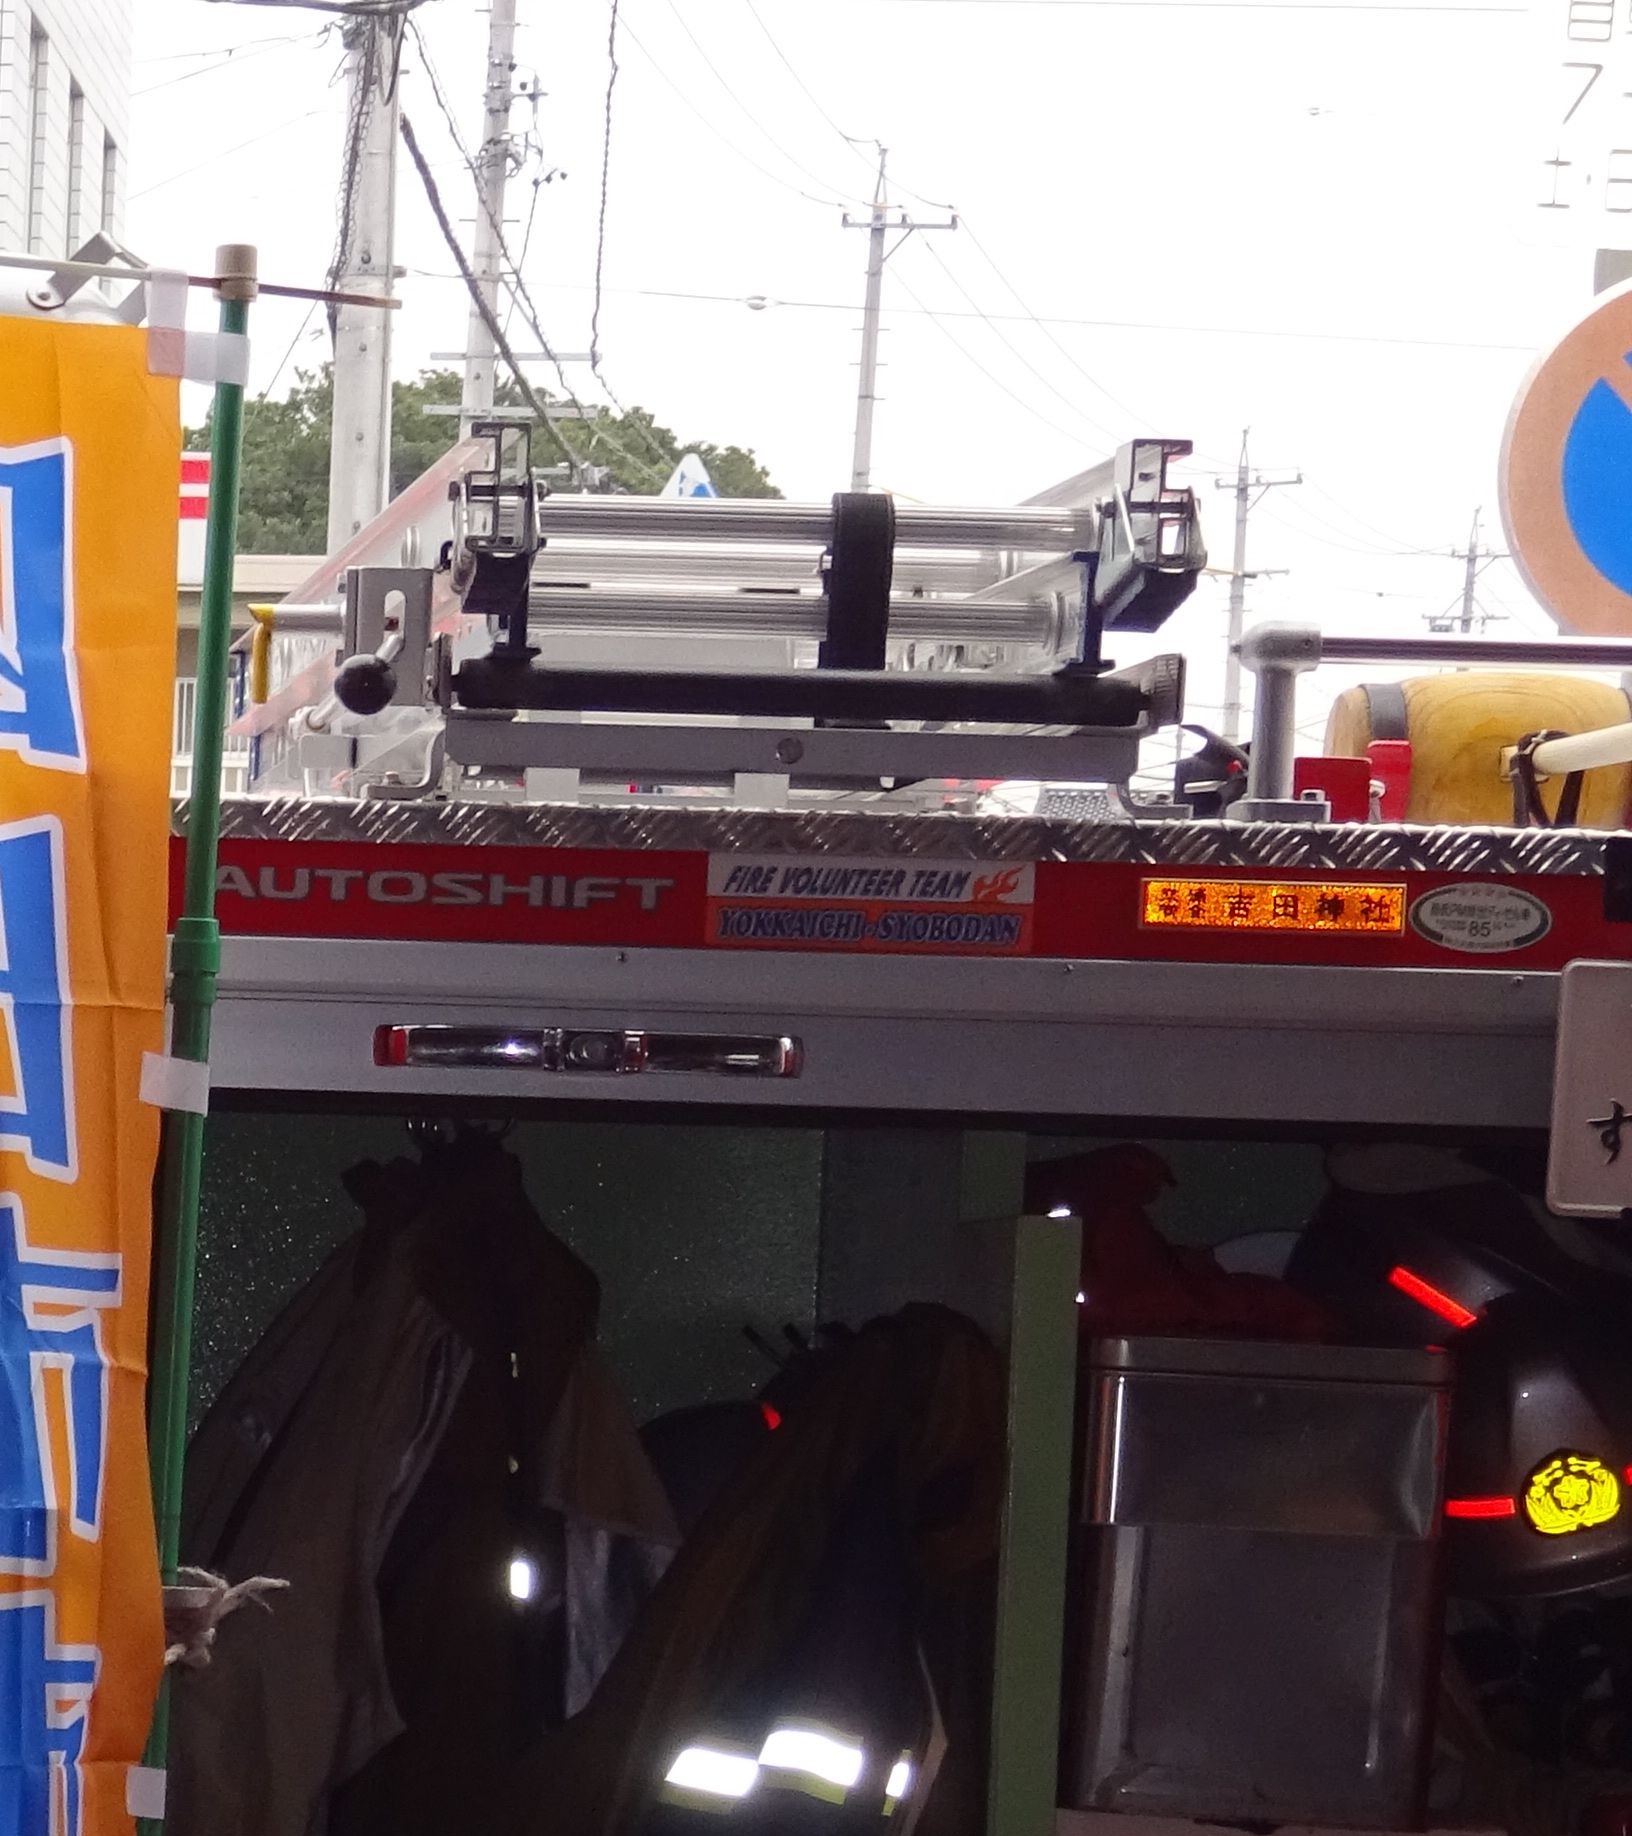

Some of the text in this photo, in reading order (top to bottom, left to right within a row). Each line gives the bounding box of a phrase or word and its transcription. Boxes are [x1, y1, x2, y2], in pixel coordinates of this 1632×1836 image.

[215, 864, 674, 911] AUTOSHIFT
[723, 865, 972, 900] FIRE VOLUNTEER TEAM
[1467, 920, 1491, 937] 85
